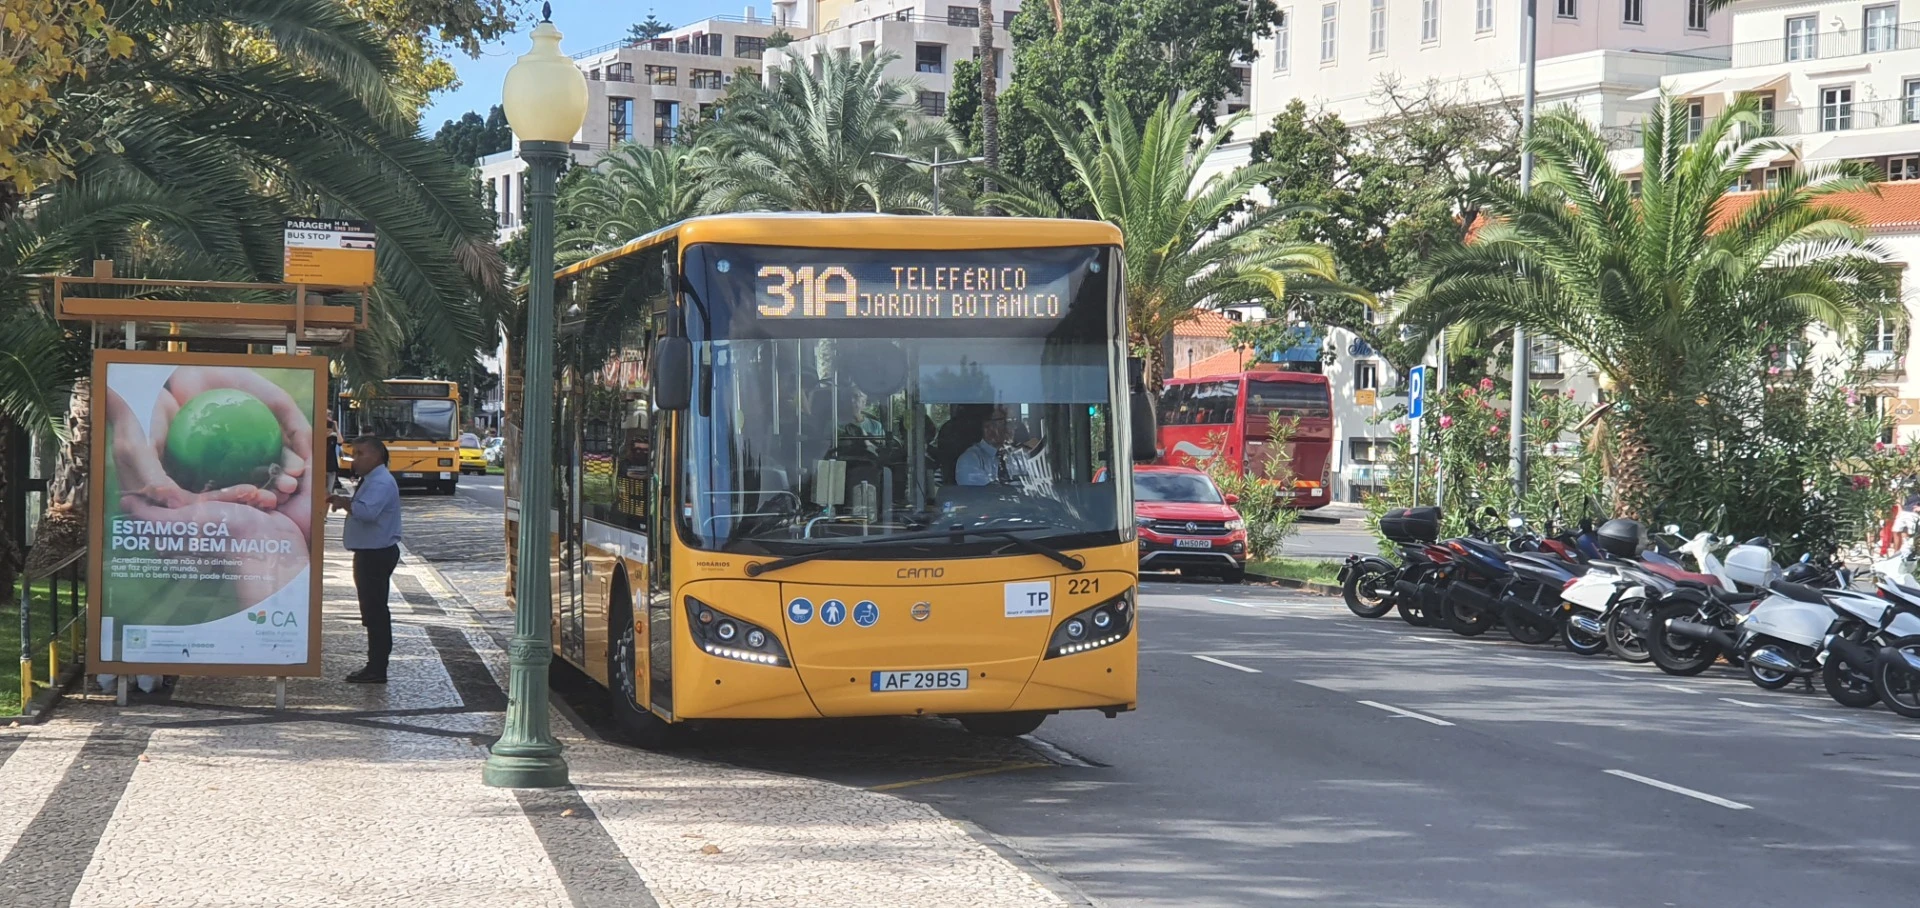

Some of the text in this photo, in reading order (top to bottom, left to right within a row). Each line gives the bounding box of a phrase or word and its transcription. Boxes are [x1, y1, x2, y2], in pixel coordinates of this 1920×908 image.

[287, 221, 331, 229] PARAGEM
[757, 266, 857, 316] 31A
[860, 293, 1059, 317] JARDIM BOTÂNICO
[1411, 372, 1421, 414] P
[112, 518, 230, 537] ESTAMOS CÁ
[112, 537, 292, 553] POR UM BEM MAIOR
[142, 564, 161, 573] girar
[169, 565, 199, 573] mundo,
[197, 557, 203, 565] é
[211, 558, 243, 566] dinheiro
[152, 571, 170, 579] bem
[200, 572, 221, 581] pode
[222, 572, 241, 580] fazer
[896, 567, 945, 578] CAMO
[1068, 578, 1099, 594] 221
[1026, 592, 1049, 606] TP
[271, 610, 298, 627] CA
